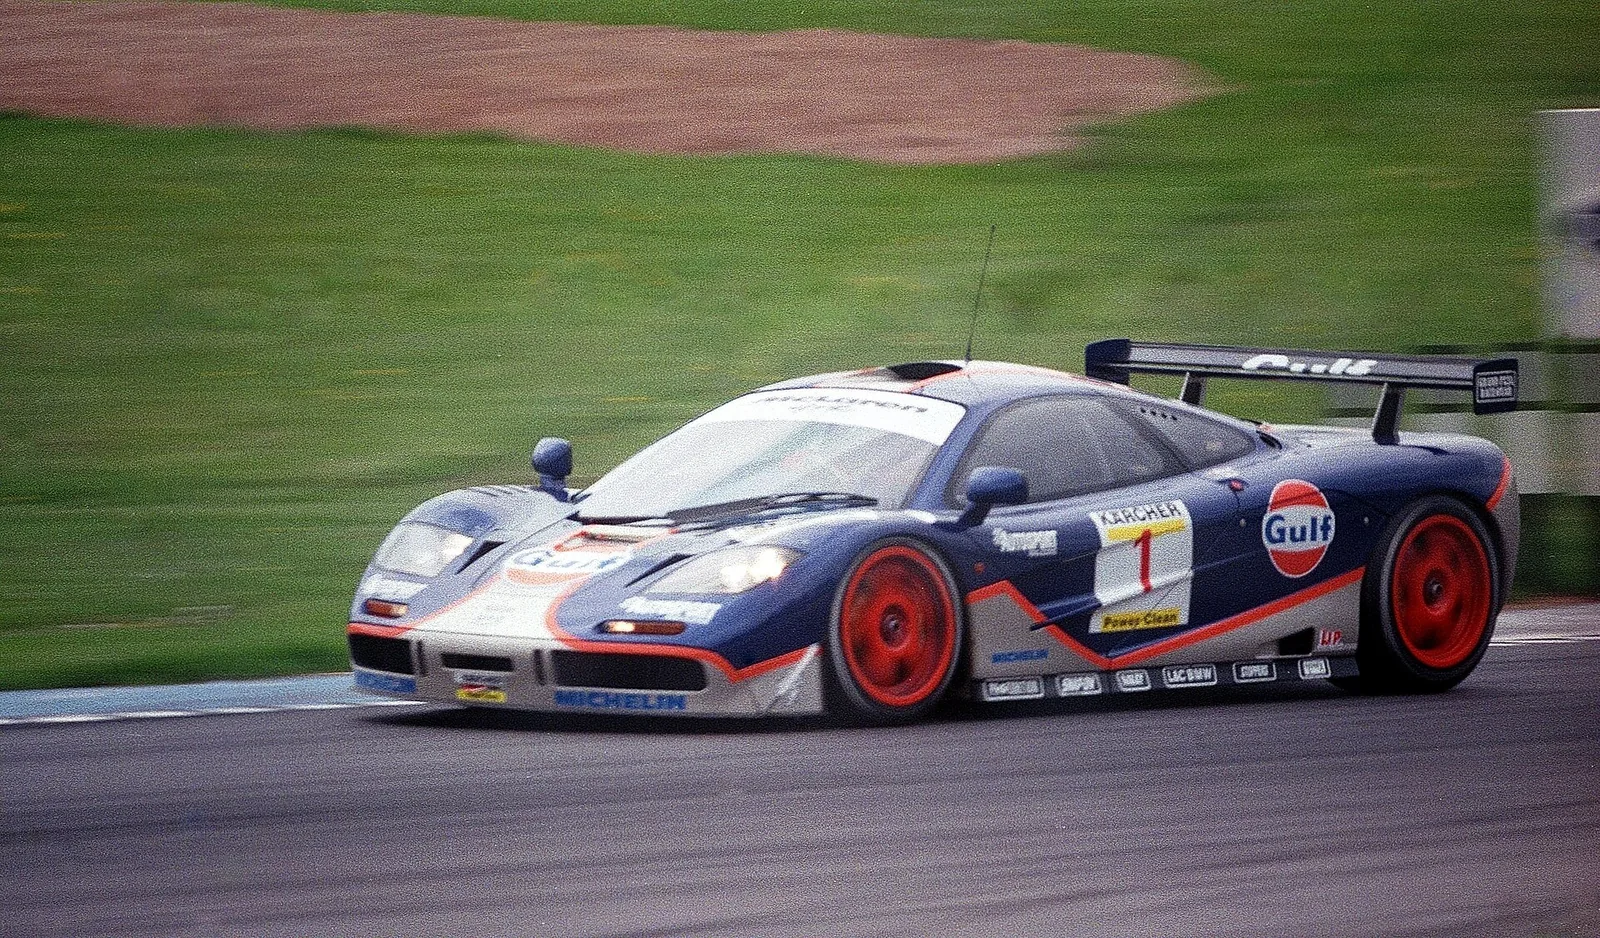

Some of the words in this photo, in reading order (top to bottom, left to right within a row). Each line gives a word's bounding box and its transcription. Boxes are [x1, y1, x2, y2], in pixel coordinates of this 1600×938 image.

[1265, 514, 1332, 544] Gulf
[513, 550, 624, 569] Gulf
[1133, 528, 1152, 594] 1
[1103, 614, 1140, 629] Power
[1143, 611, 1178, 625] Clean
[553, 689, 687, 711] MICHELIN
